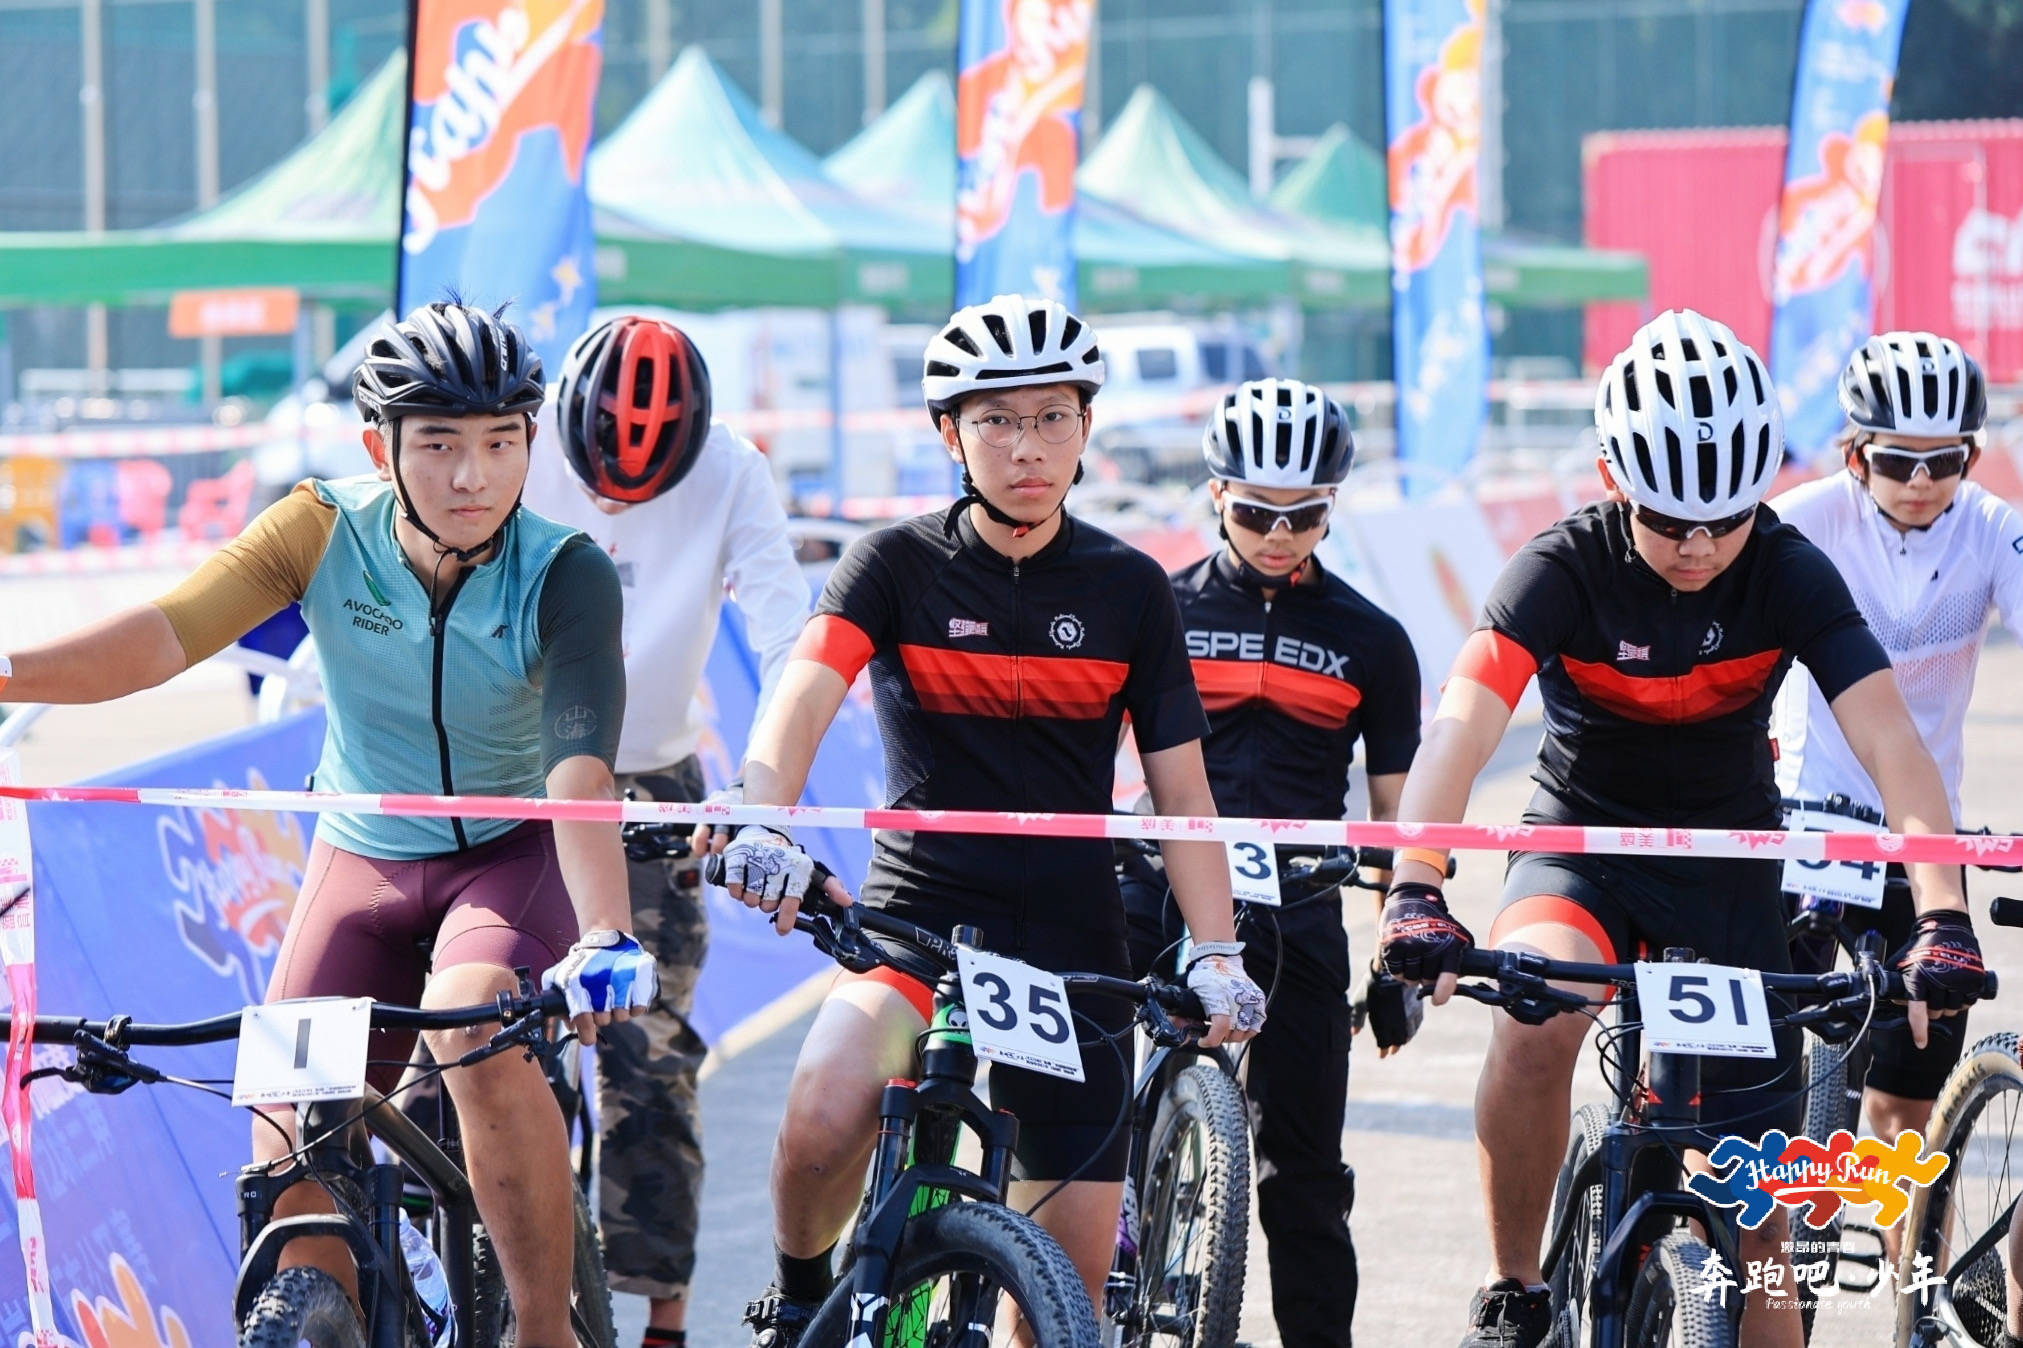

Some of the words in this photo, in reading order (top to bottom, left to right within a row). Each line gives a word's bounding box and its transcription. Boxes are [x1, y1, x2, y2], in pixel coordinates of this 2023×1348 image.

[352, 615, 389, 637] RIDER
[1185, 630, 1350, 679] SPEEDX
[1233, 842, 1272, 880] 3
[972, 972, 1070, 1044] 35
[1668, 975, 1749, 1026] 51
[293, 1018, 312, 1069] 1
